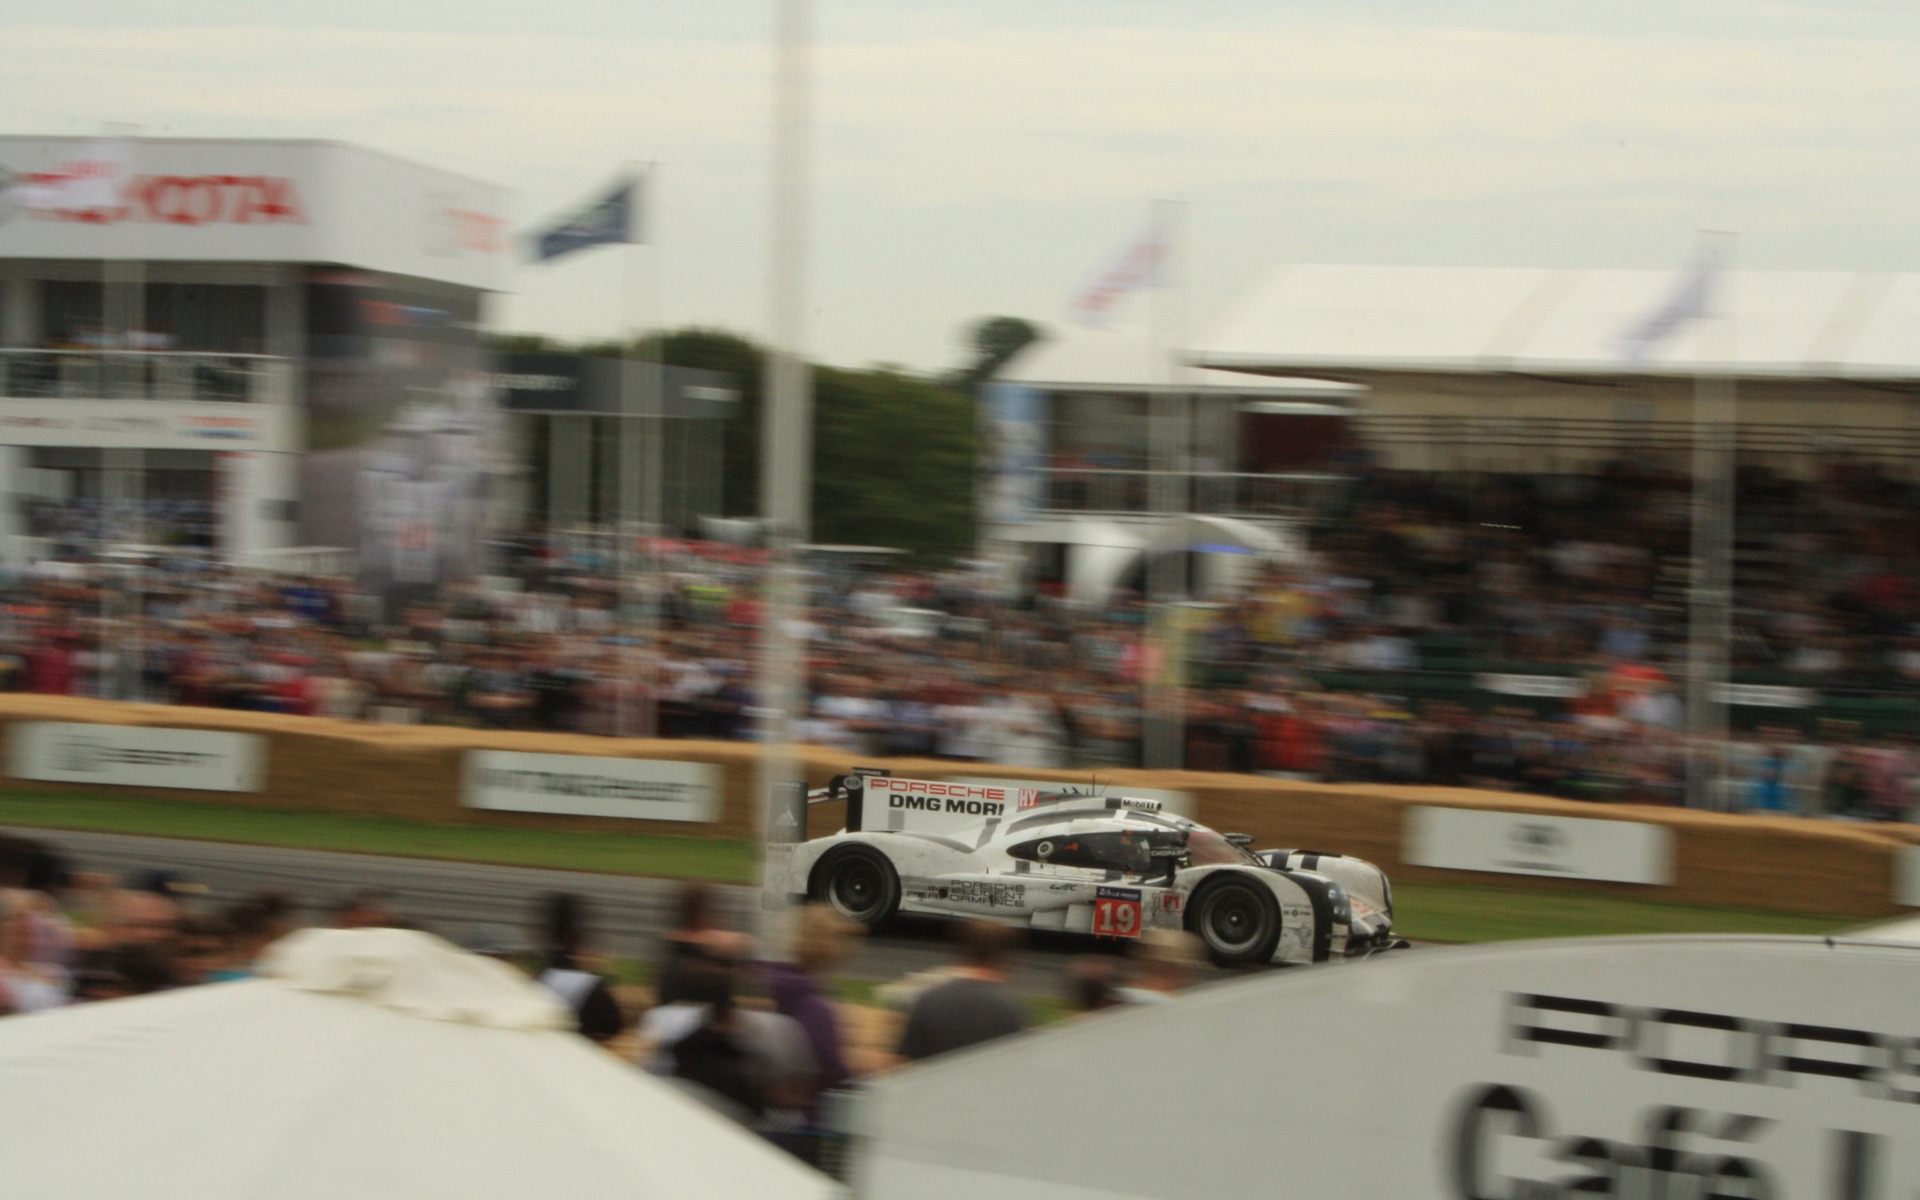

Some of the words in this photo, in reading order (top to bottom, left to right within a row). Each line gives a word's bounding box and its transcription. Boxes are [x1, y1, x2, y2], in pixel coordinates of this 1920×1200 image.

[870, 778, 1005, 800] PORSCHE
[889, 794, 941, 811] DMG
[1122, 799, 1146, 809] Mobil
[951, 880, 1025, 892] PORSCHE
[1100, 902, 1136, 933] 19
